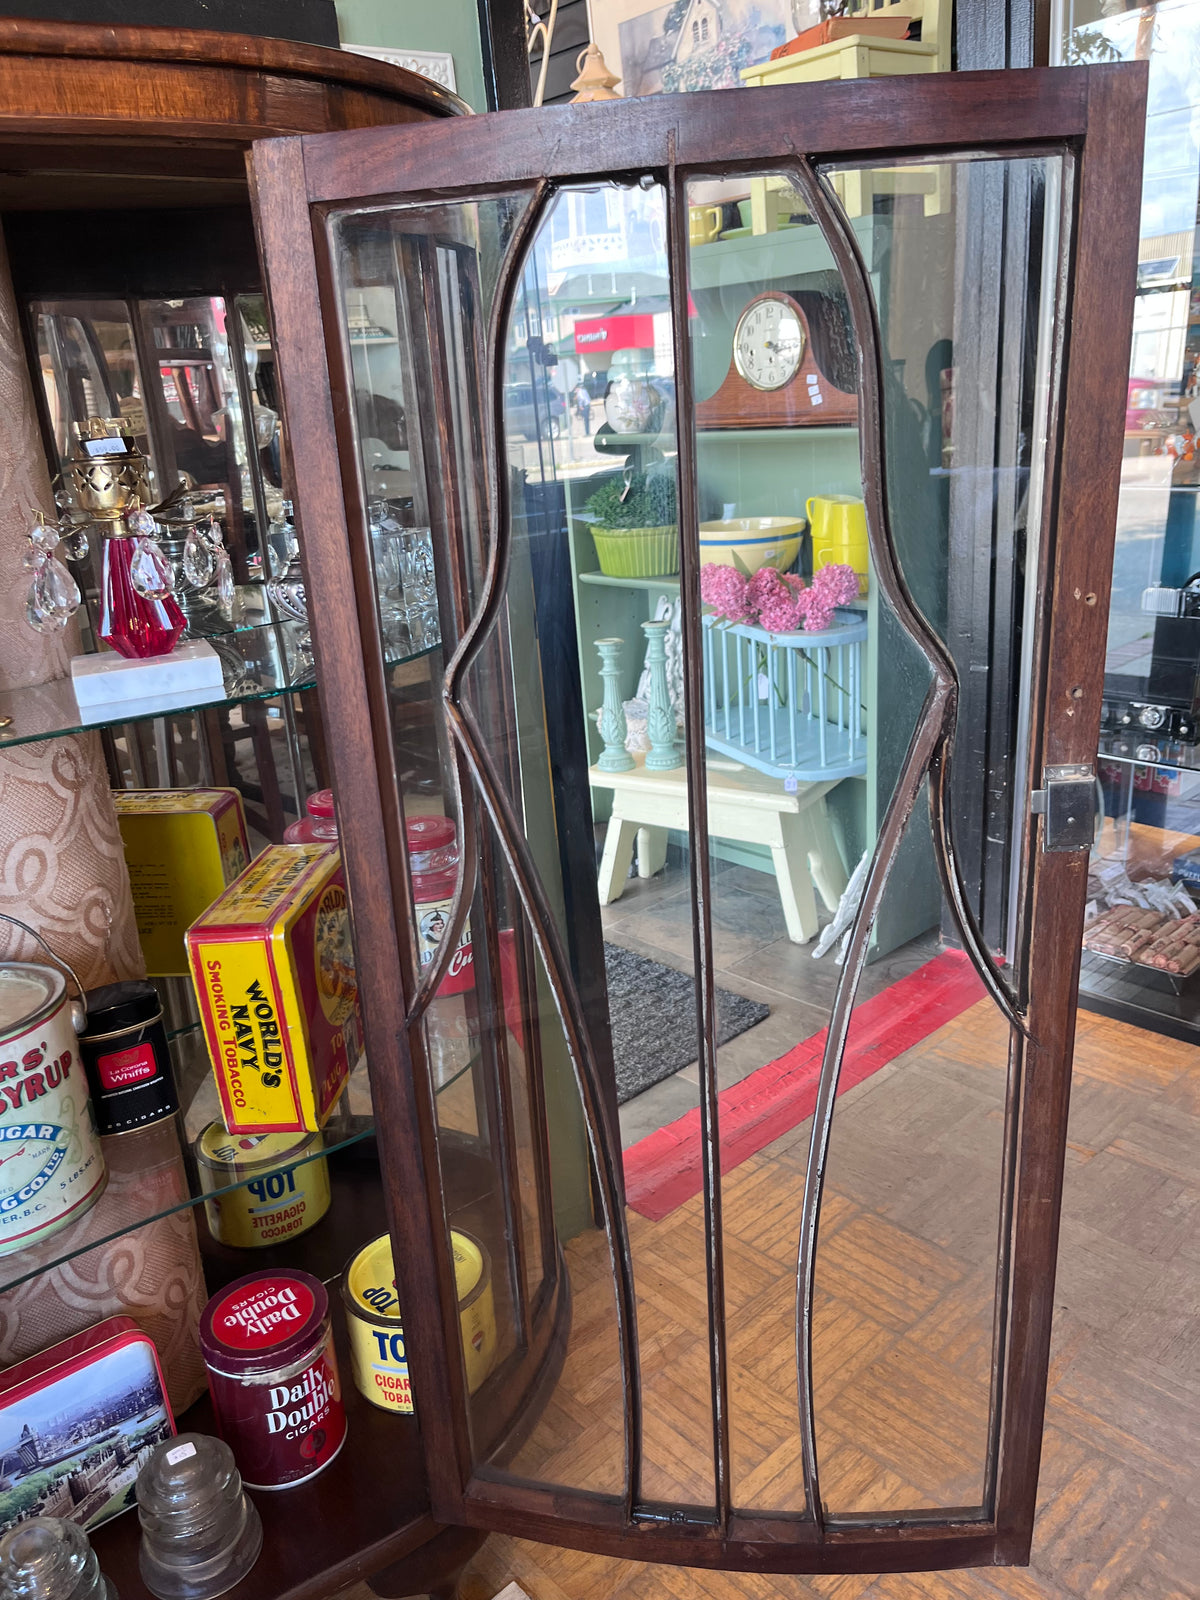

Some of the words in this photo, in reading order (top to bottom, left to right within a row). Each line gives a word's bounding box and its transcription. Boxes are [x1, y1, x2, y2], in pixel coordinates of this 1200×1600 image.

[206, 960, 231, 1031] SMOKING
[223, 1037, 247, 1108] TOBACCO
[230, 1004, 260, 1072] NAVY
[245, 979, 283, 1088] WORLD'S
[0, 1041, 47, 1083] RS'
[108, 1068, 120, 1076] La
[120, 1060, 148, 1073] Corona
[110, 1066, 151, 1083] Whiffs
[126, 1104, 171, 1125] CIGARS
[223, 1287, 299, 1328] Double
[231, 1286, 276, 1310] CIGARS
[246, 1303, 302, 1337] Daily
[372, 1330, 407, 1363] TO
[268, 1363, 326, 1410] Daily
[374, 1373, 411, 1391] CIGAR
[382, 1390, 412, 1404] TOBA
[265, 1378, 336, 1434] Double
[285, 1406, 331, 1440] CIGARS
